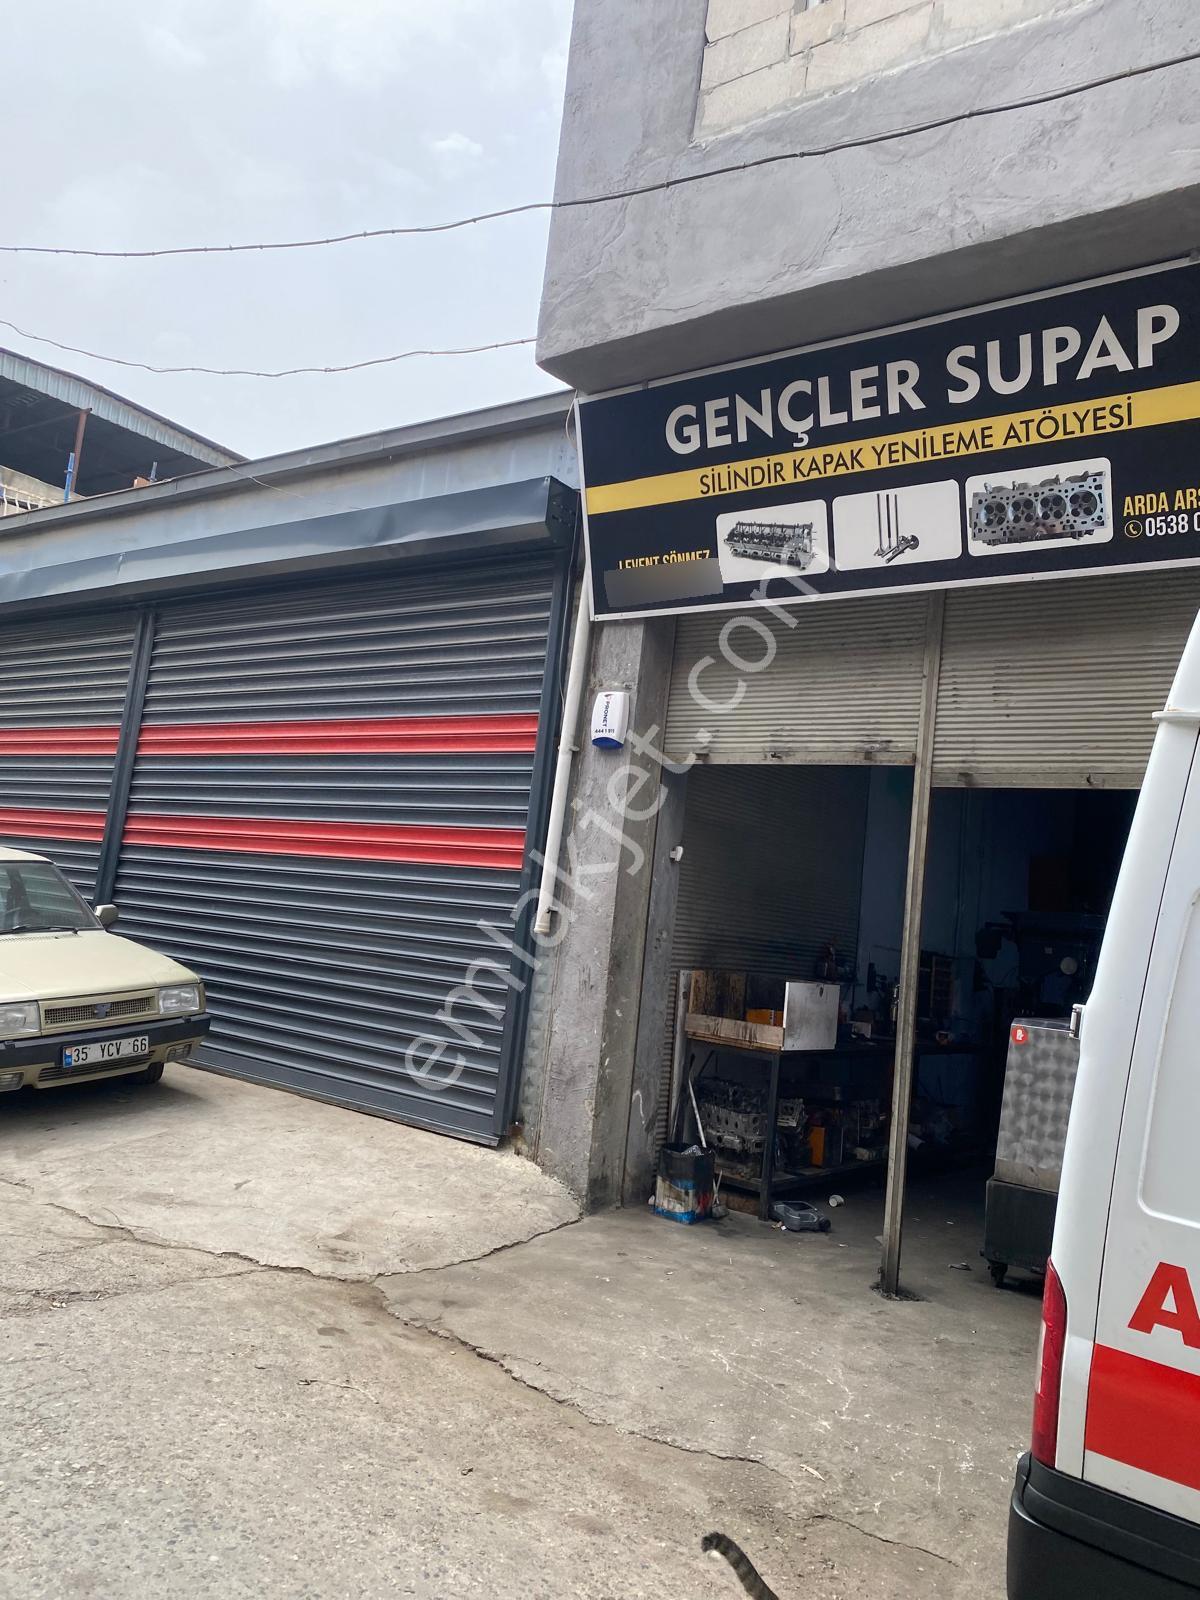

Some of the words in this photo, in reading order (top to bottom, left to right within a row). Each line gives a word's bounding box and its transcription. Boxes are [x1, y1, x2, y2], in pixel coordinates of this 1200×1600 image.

[665, 359, 927, 455] GENÇLER
[945, 304, 1180, 404] SUPAP
[699, 457, 786, 495] SİLİNDİR
[793, 447, 865, 480] KAPAK
[871, 425, 994, 466] YENİLEME
[1002, 395, 1133, 446] ATÖLYESİ
[1123, 491, 1169, 517] ARDA
[1174, 488, 1200, 511] AR
[1145, 513, 1189, 537] 0538
[73, 1047, 88, 1063] 35
[100, 1041, 122, 1058] YCV
[132, 1038, 147, 1053] 66
